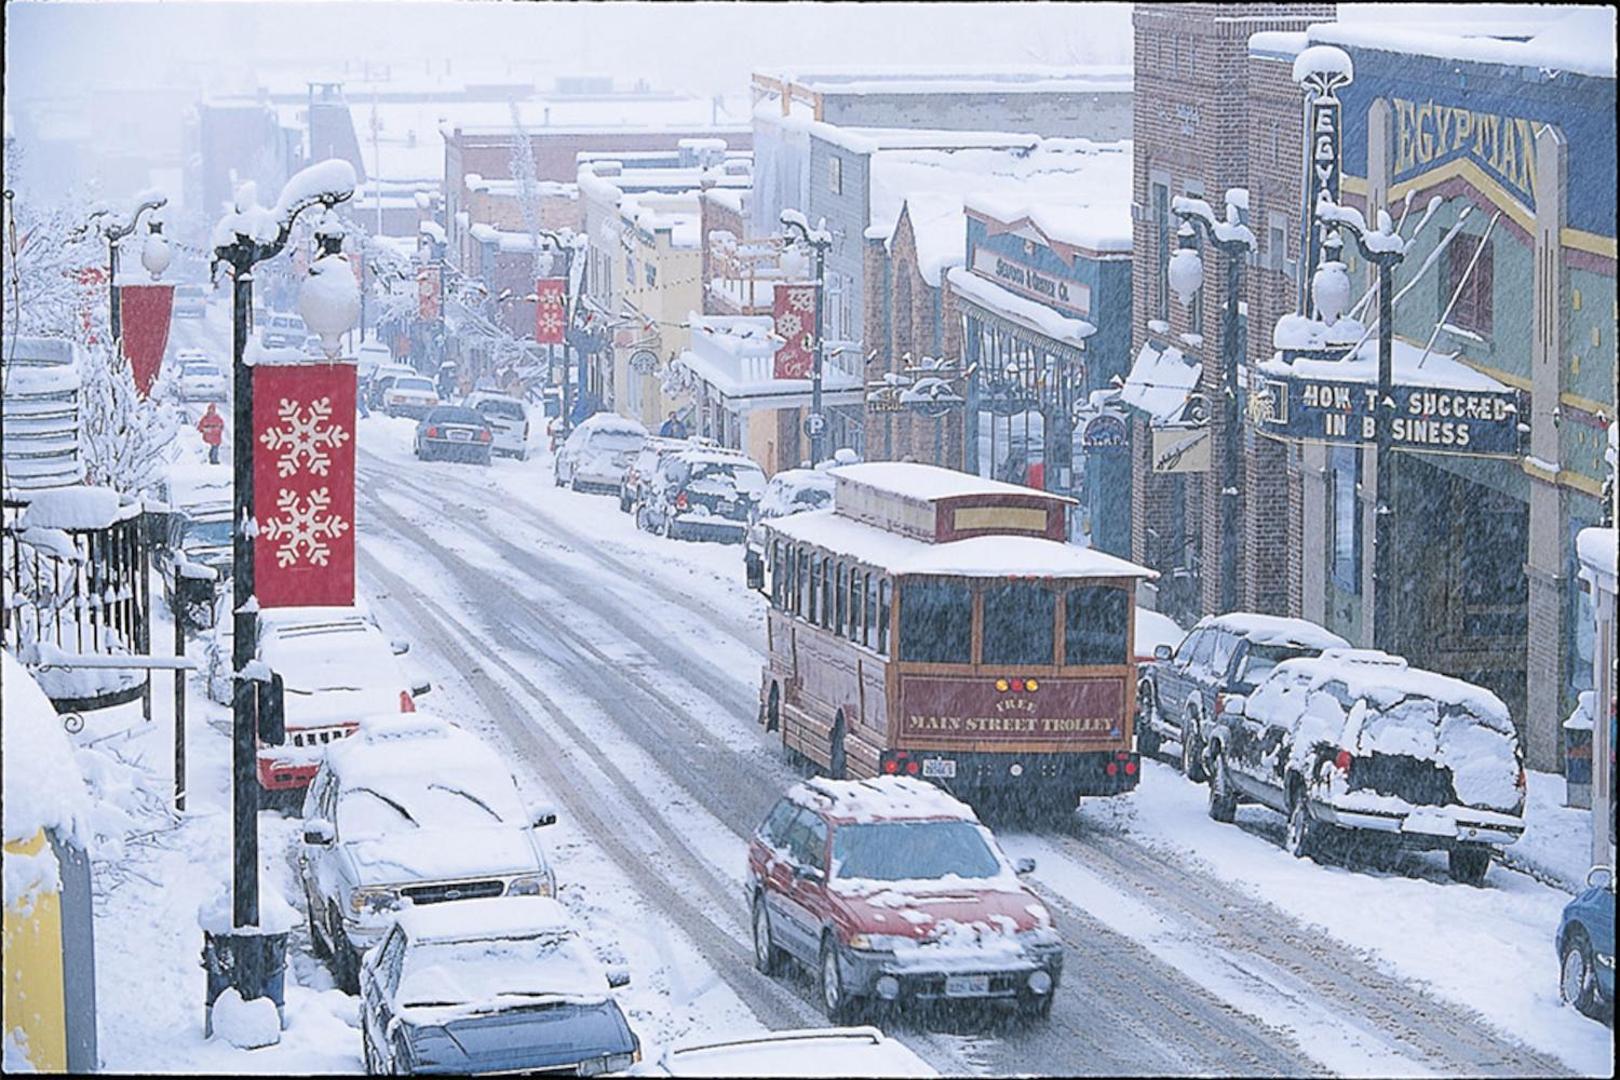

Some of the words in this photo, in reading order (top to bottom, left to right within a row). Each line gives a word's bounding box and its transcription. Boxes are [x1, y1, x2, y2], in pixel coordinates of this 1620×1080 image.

[1393, 98, 1541, 203] EGYPTIAN
[1303, 384, 1351, 409] HOW
[810, 418, 824, 434] P
[1325, 414, 1346, 436] IN
[1363, 417, 1470, 445] BSINESS
[995, 698, 1037, 714] FREE
[909, 715, 962, 730] MAIN
[965, 717, 1038, 732] STREET
[1041, 718, 1114, 733] TROLLEY
